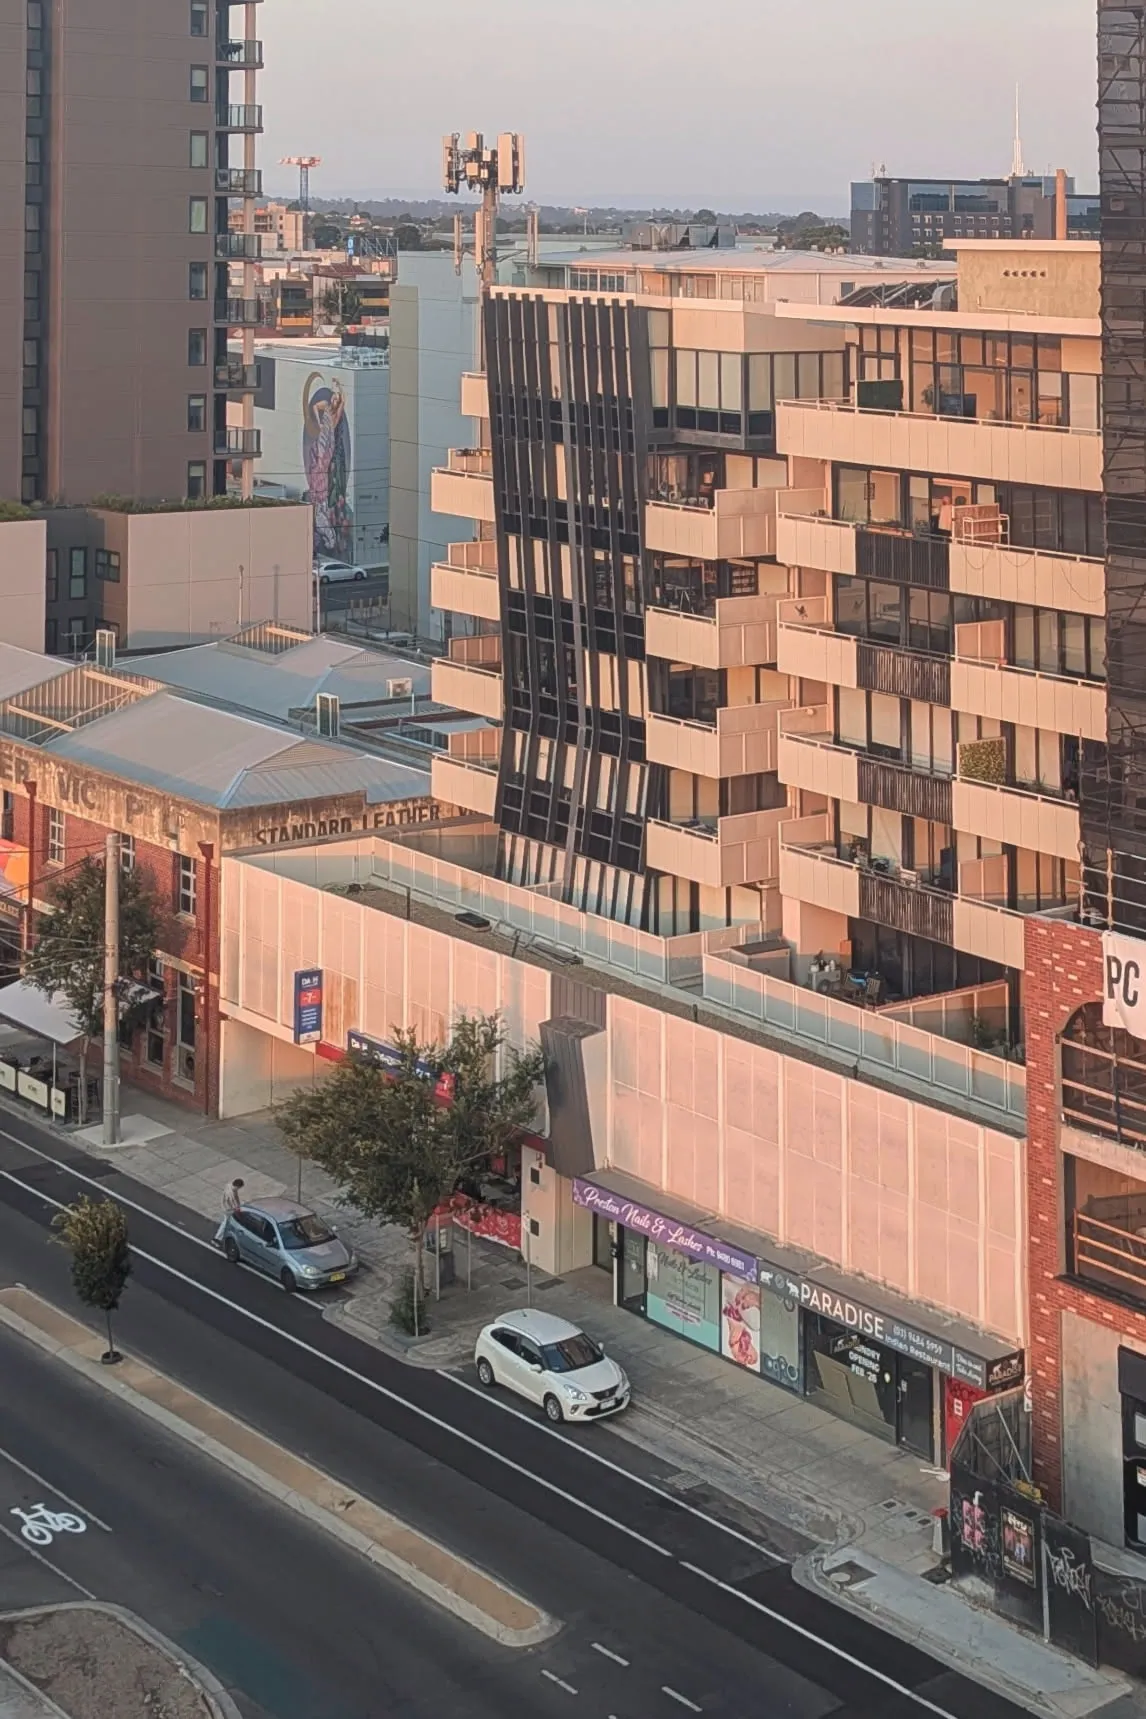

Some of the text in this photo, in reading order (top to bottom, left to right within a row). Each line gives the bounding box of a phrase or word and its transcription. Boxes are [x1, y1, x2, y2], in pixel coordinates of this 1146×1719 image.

[256, 817, 352, 845] STANDARD
[1106, 954, 1140, 1008] PC
[584, 1187, 620, 1215] Preston
[621, 1203, 651, 1229] Nails
[652, 1218, 666, 1238] &
[667, 1226, 703, 1252] Lashes
[800, 1283, 884, 1339] PARADISE
[885, 1335, 951, 1371] Indian Restaurant
